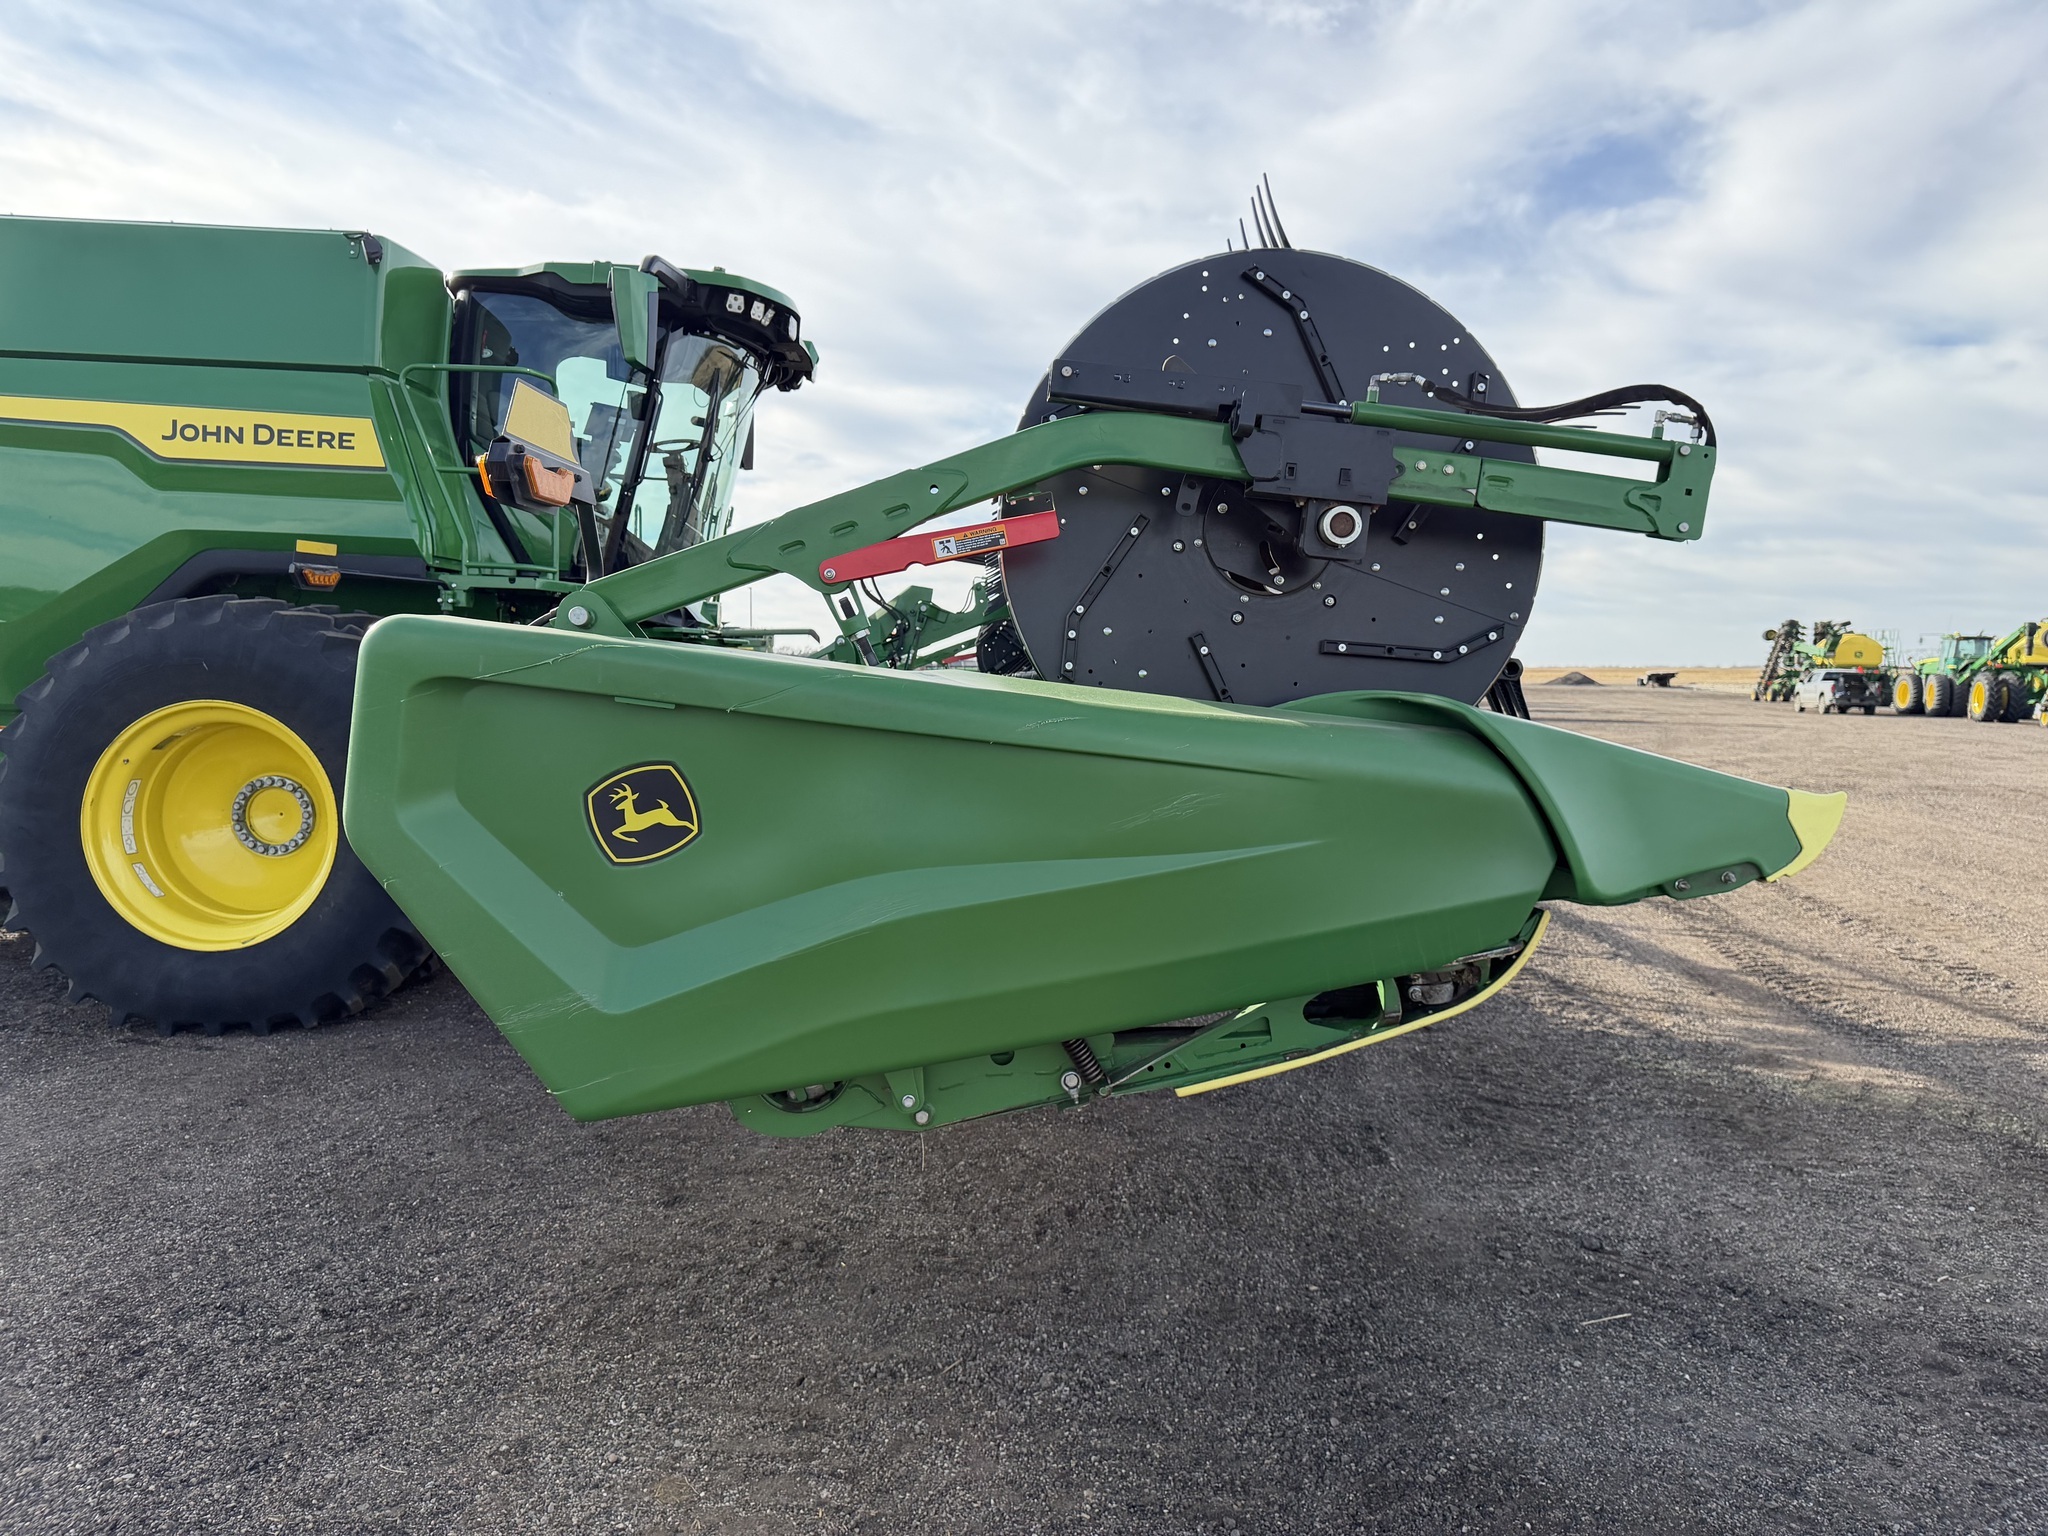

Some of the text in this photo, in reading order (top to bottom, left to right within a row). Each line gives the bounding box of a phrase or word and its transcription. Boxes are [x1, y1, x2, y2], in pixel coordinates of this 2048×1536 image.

[1123, 373, 1131, 384] 3
[1177, 379, 1186, 390] 2
[161, 419, 355, 450] JOHN DEERE
[969, 527, 997, 536] WARNING
